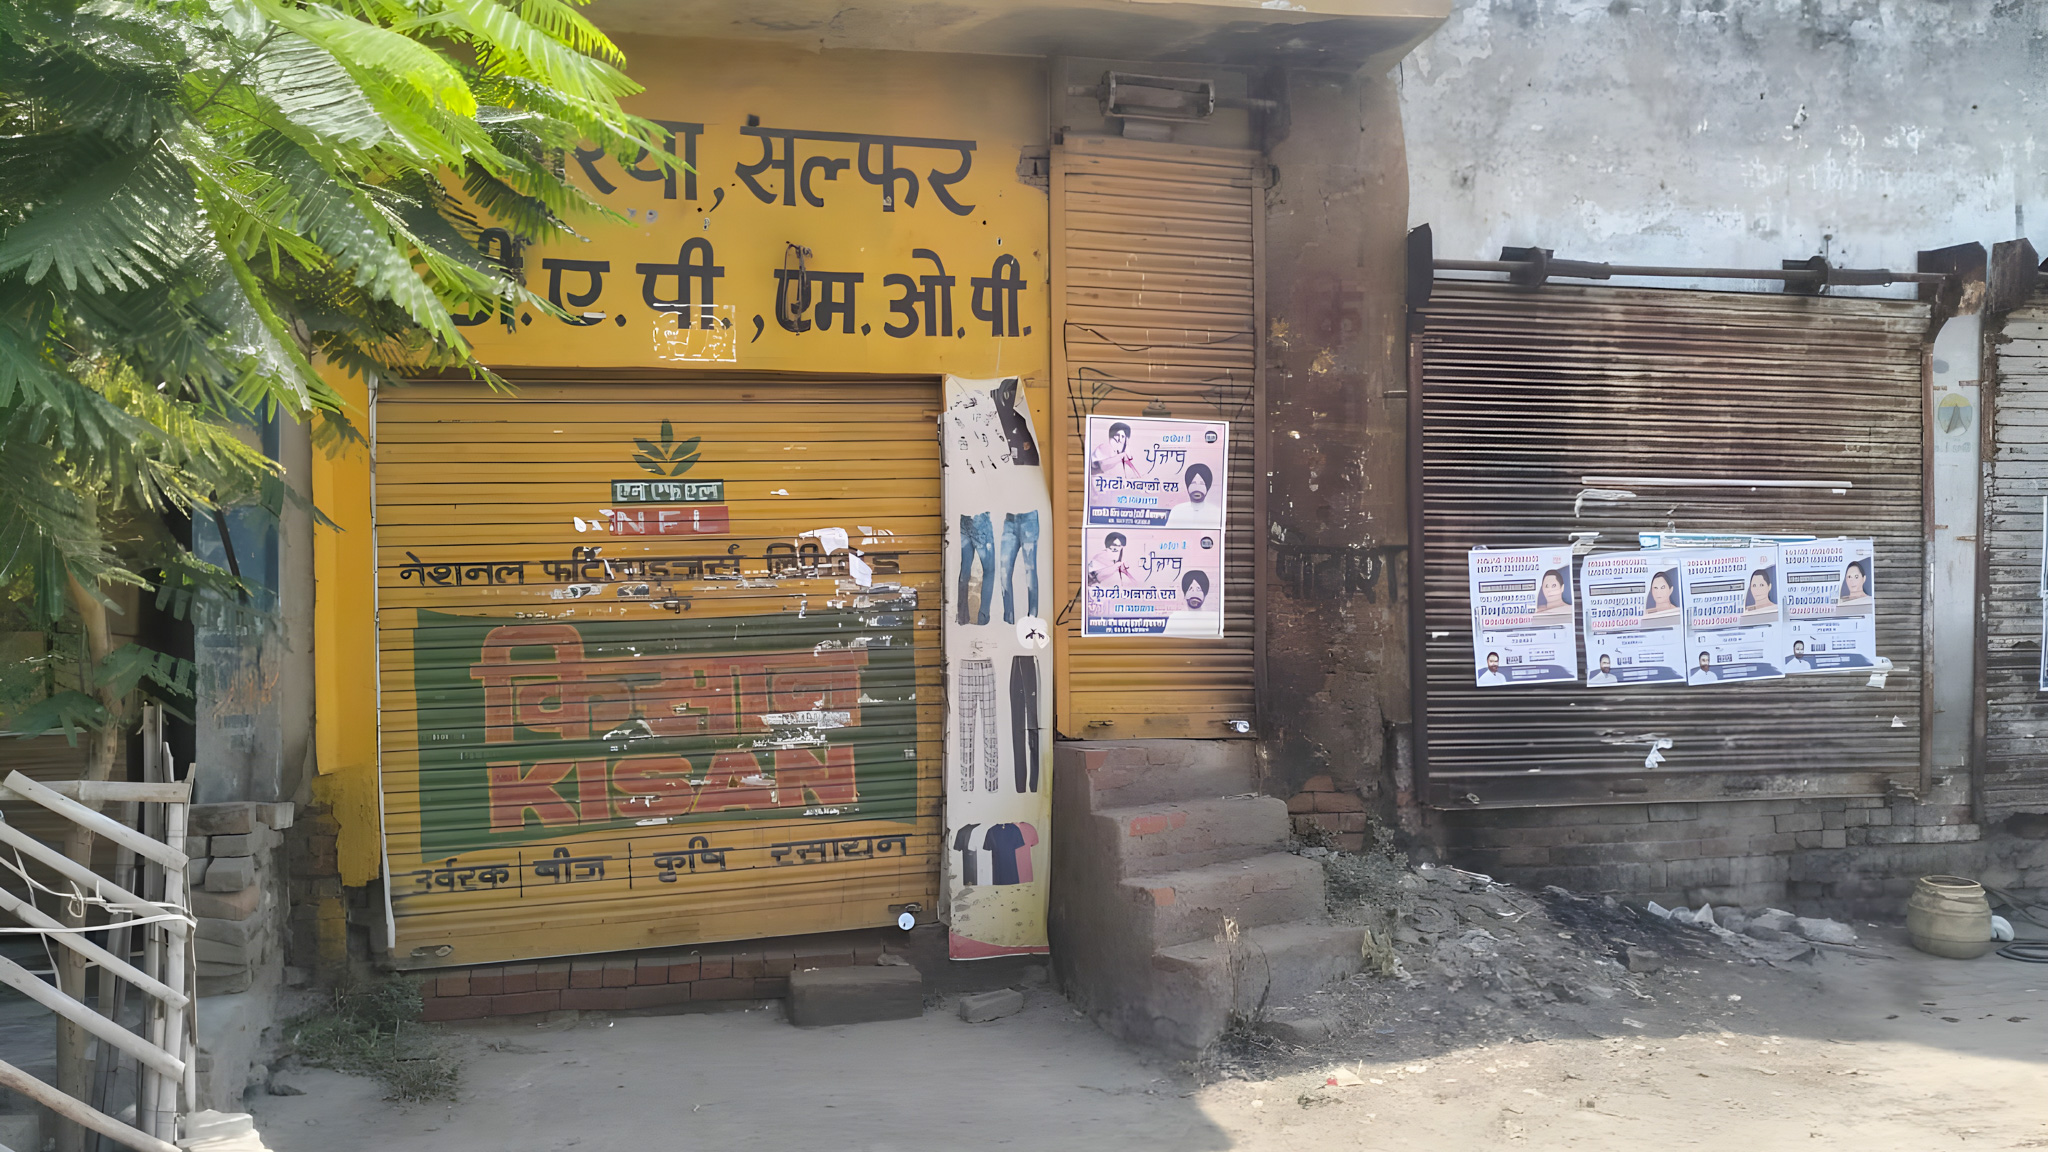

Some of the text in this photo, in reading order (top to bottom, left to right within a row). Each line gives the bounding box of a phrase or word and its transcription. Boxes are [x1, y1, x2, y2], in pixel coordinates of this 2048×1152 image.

[734, 125, 978, 217] सल्फर
[399, 551, 530, 587] नेशनल
[487, 743, 858, 834] KISAN
[532, 846, 613, 884] बीज
